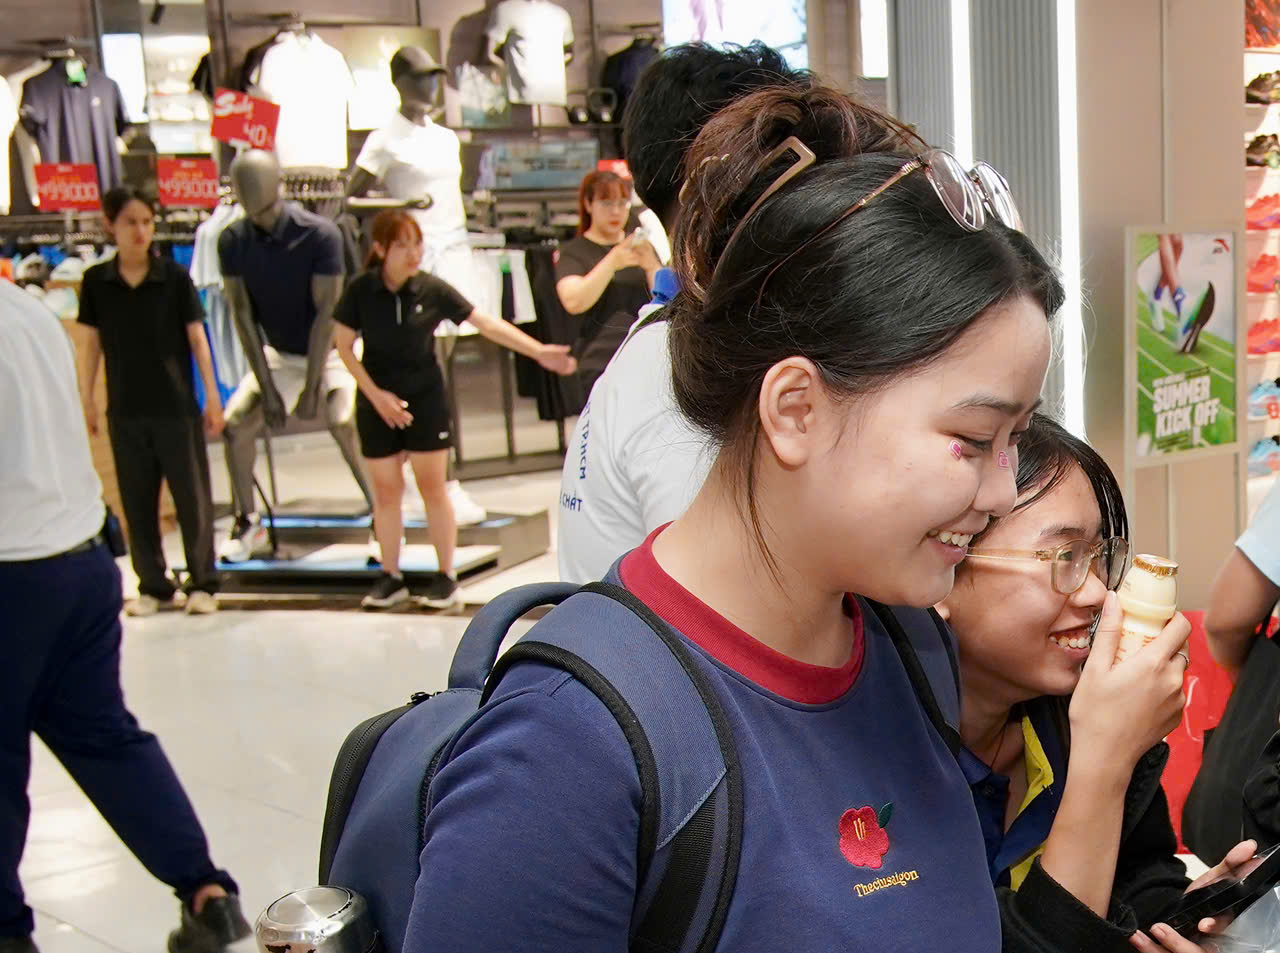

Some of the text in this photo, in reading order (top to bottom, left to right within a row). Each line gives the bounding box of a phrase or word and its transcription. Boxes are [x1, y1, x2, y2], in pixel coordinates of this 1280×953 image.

[1153, 375, 1211, 413] SUMMER
[1156, 398, 1220, 439] KICK OFF
